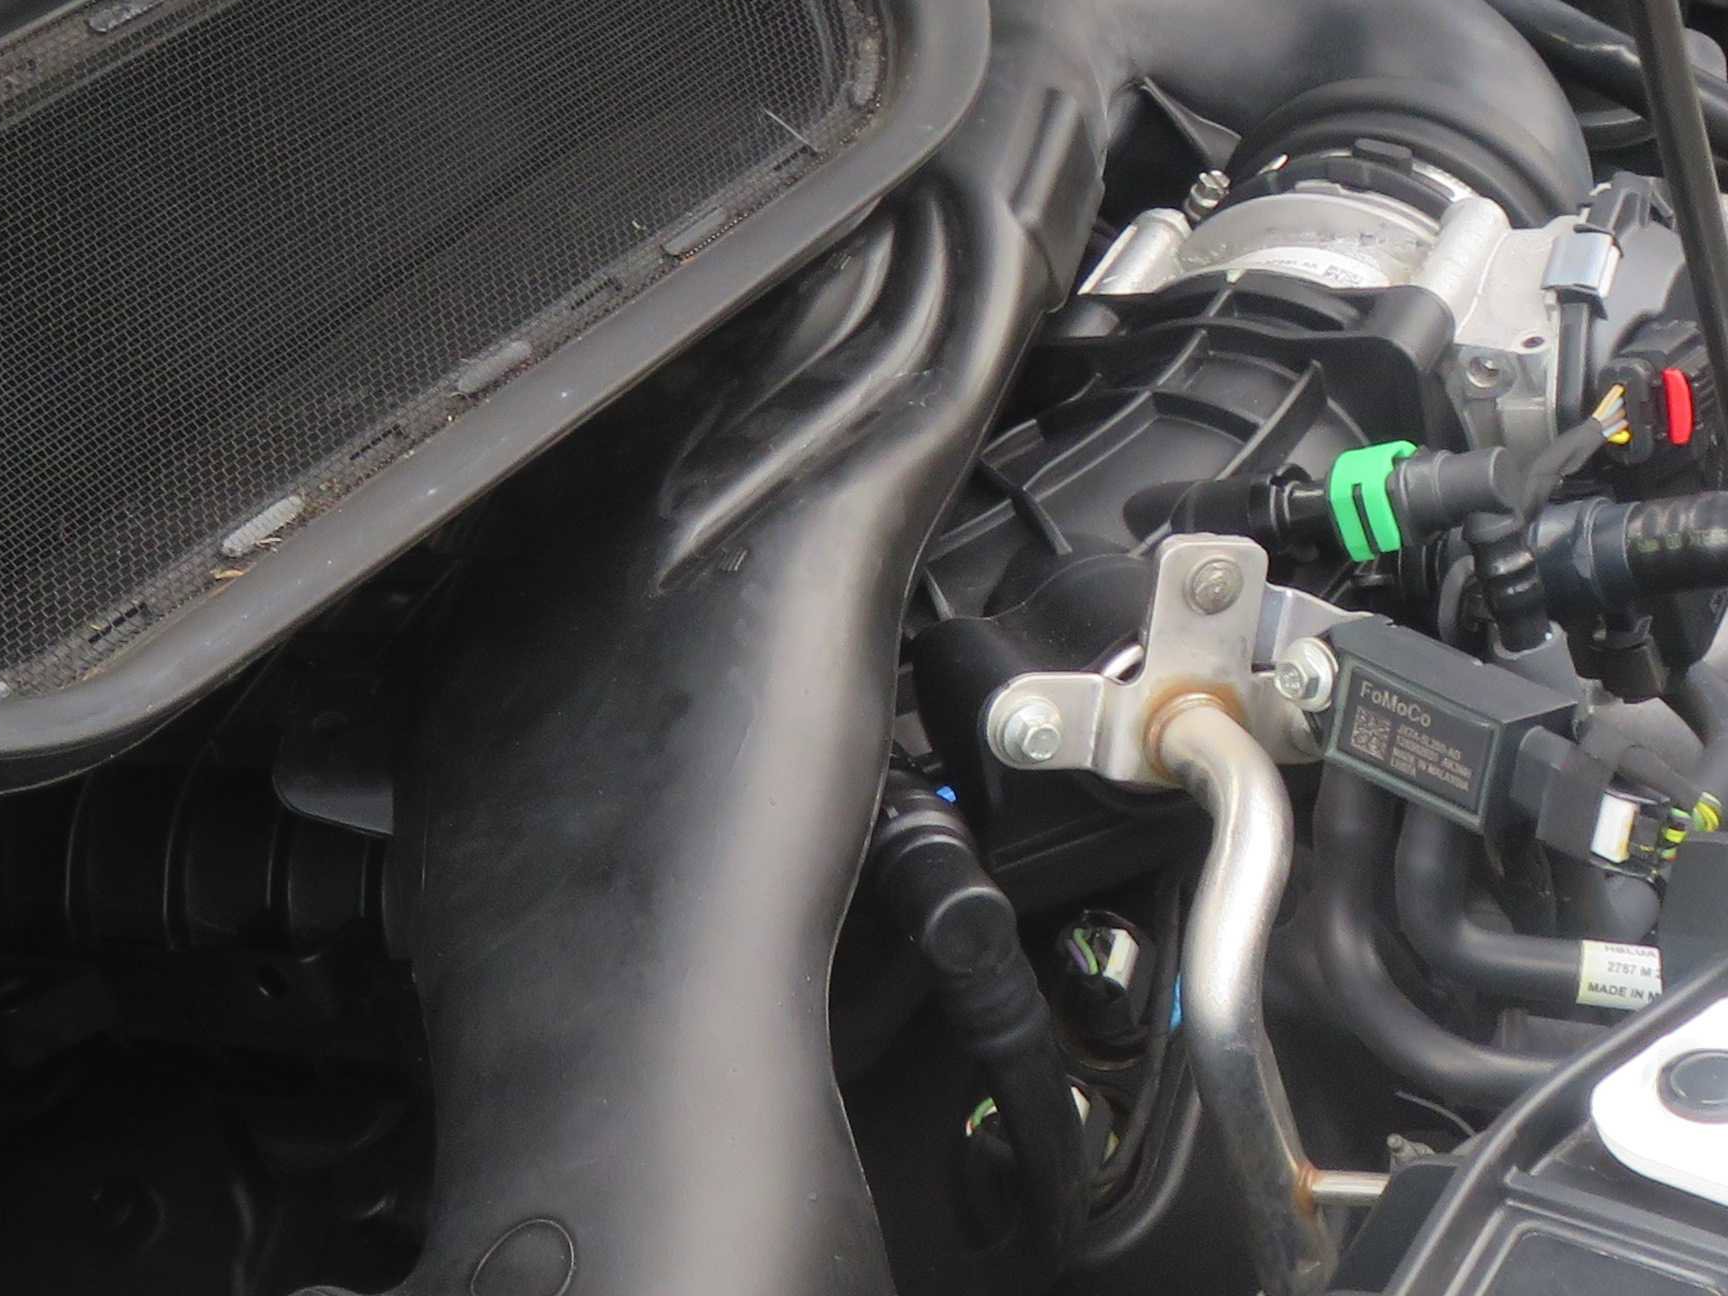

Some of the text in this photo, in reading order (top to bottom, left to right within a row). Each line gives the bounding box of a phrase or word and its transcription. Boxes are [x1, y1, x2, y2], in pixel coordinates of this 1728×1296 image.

[1360, 680, 1431, 727] FoMoCo
[1587, 982, 1627, 998] MADE
[1630, 988, 1644, 1001] IN
